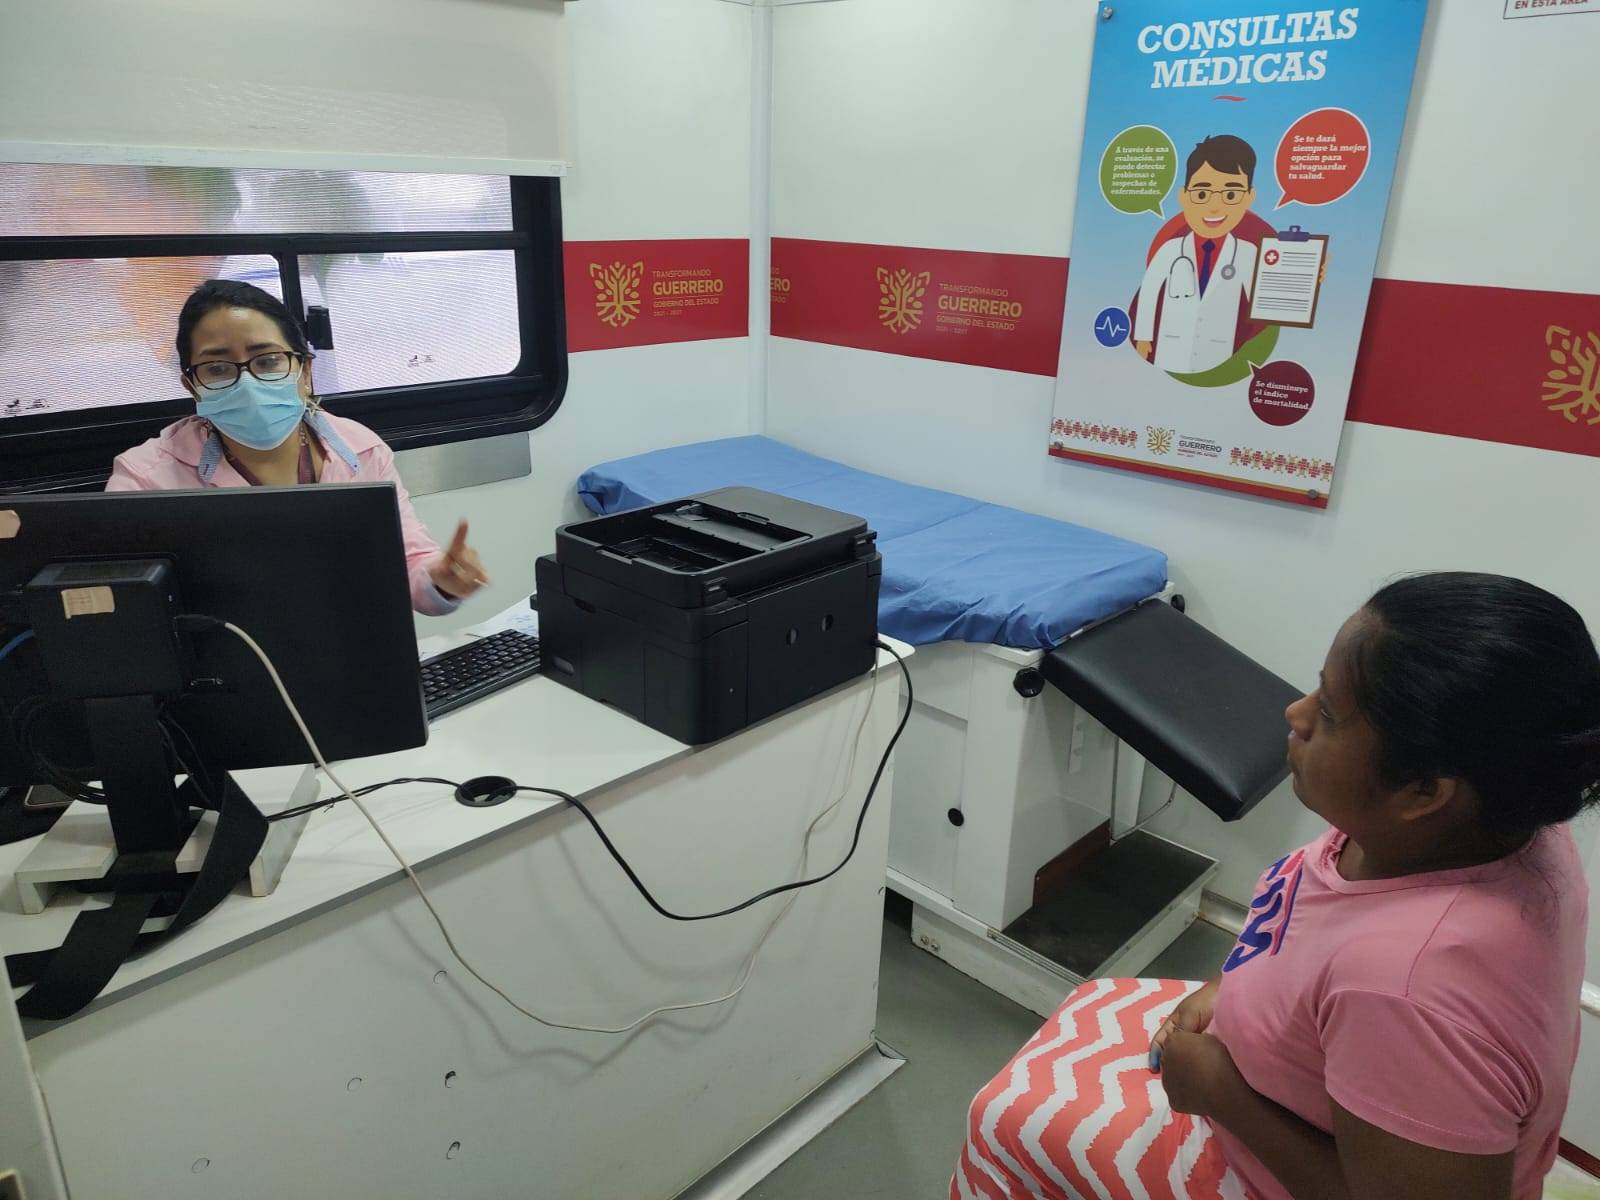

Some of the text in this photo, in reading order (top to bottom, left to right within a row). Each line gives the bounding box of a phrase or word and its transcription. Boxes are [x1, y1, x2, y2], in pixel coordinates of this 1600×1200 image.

[1514, 0, 1528, 9] EN
[1137, 8, 1360, 54] CONSULTAS
[1151, 49, 1328, 89] MÉDICAS
[1316, 134, 1336, 142] dará
[1292, 144, 1328, 153] siempre
[1339, 144, 1367, 153] mejor
[1290, 154, 1342, 163] opción para
[1289, 162, 1347, 172] salvaguardar
[1298, 172, 1325, 180] salud.
[652, 279, 724, 296] GUERRERO
[938, 295, 1023, 318] GUERRERO
[1255, 380, 1309, 394] Se disminuye
[1178, 440, 1223, 453] GUERRERO
